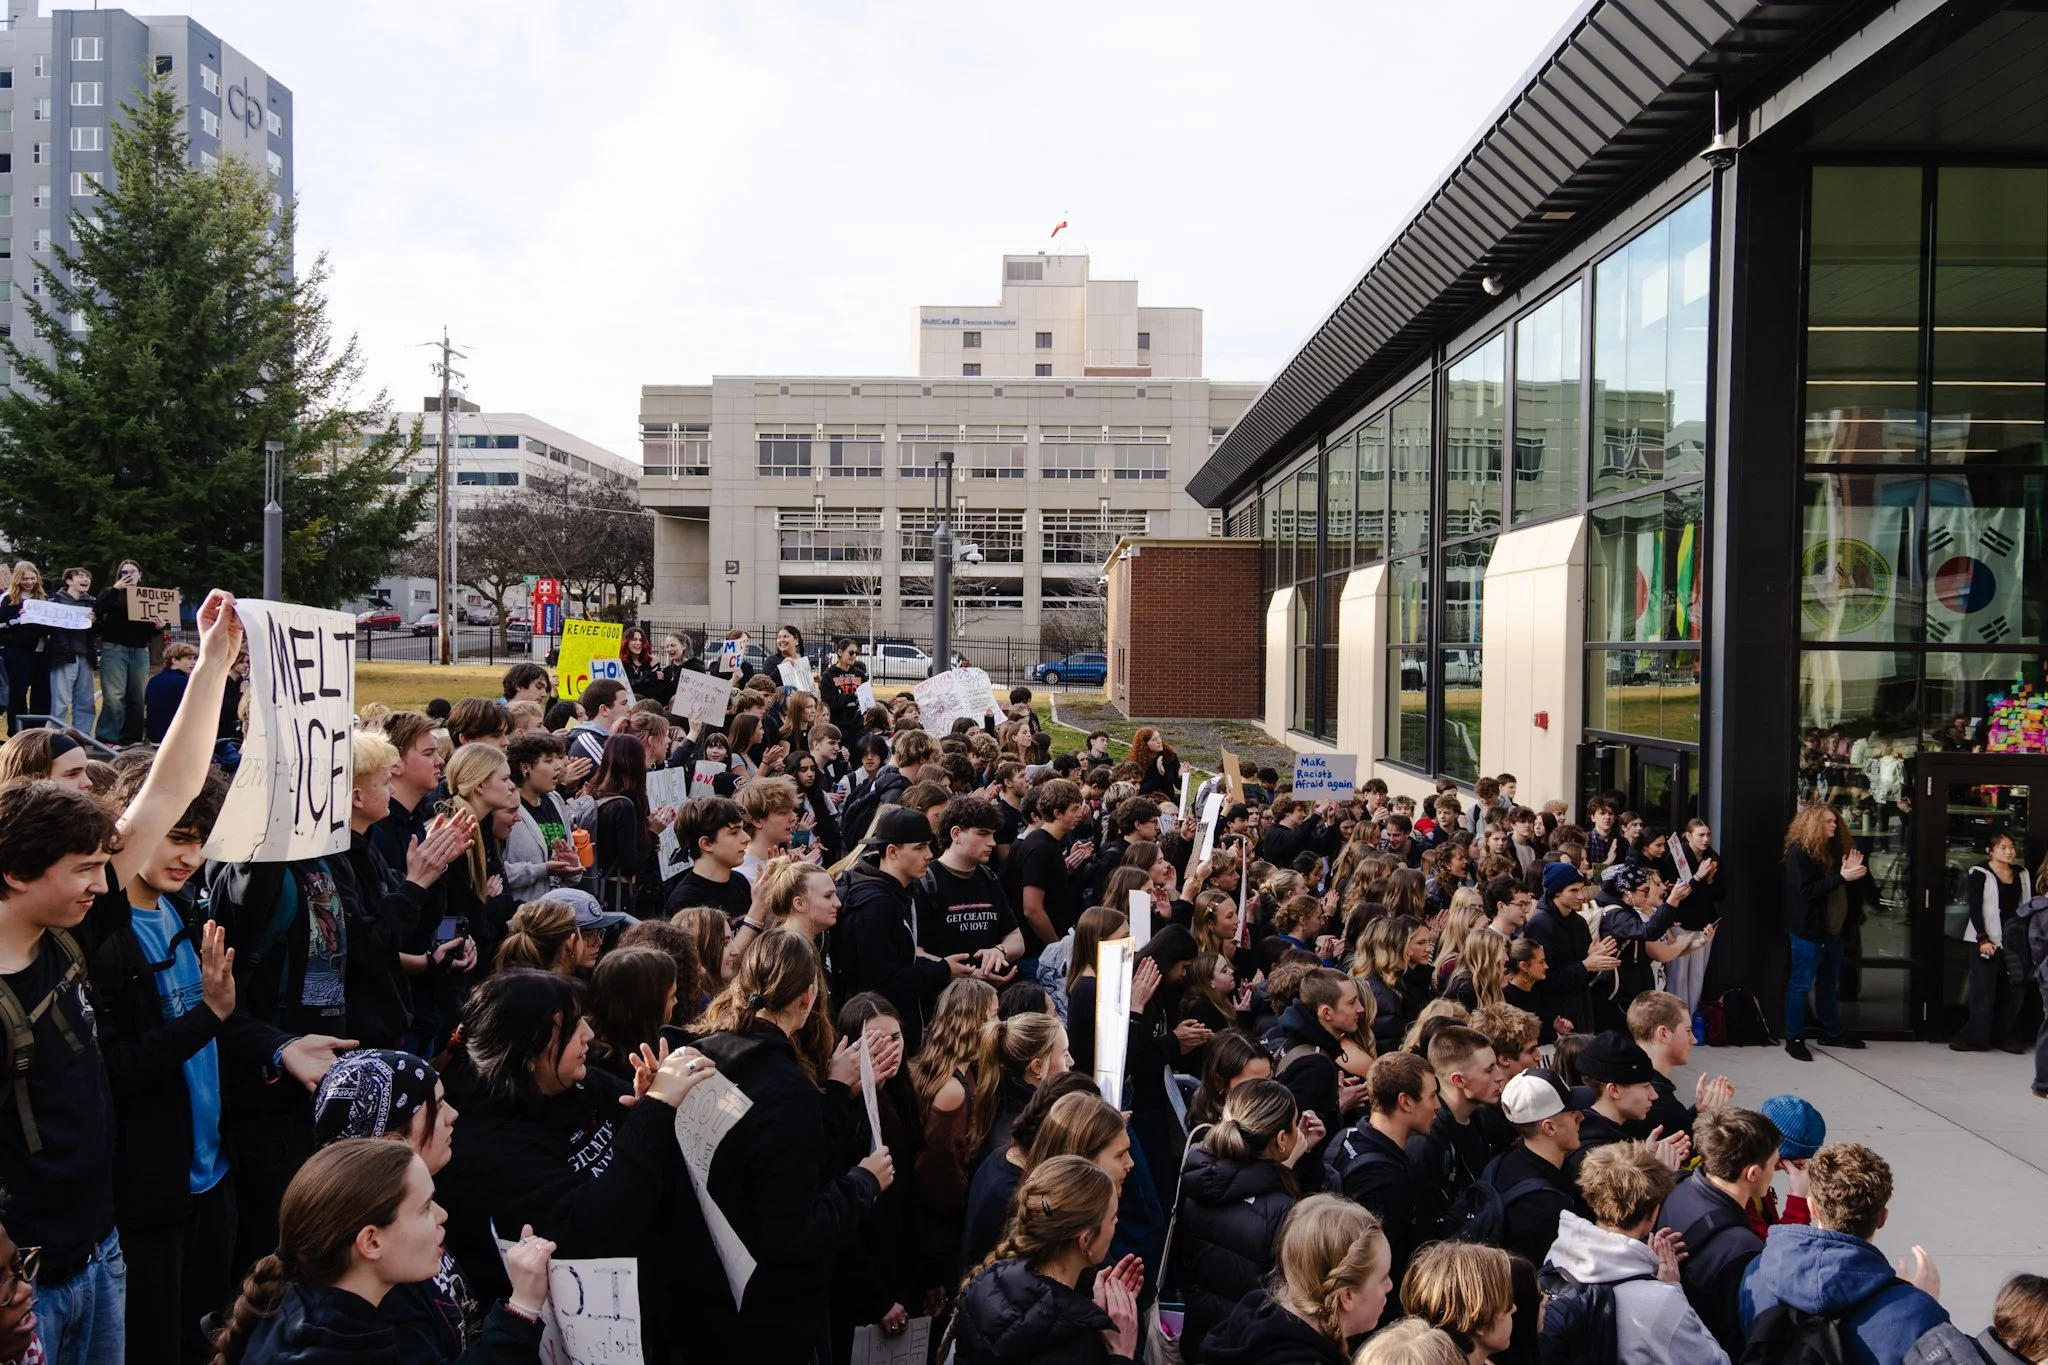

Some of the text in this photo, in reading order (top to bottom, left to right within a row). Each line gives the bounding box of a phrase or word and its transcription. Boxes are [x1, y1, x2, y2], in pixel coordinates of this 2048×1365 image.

[136, 588, 175, 602] ABOLISH
[567, 623, 620, 640] RENEE GOOD
[266, 611, 356, 705] MELT
[1295, 780, 1324, 789] Afraid
[946, 911, 998, 924] GET CREATIVE
[959, 921, 989, 932] IN LOVE
